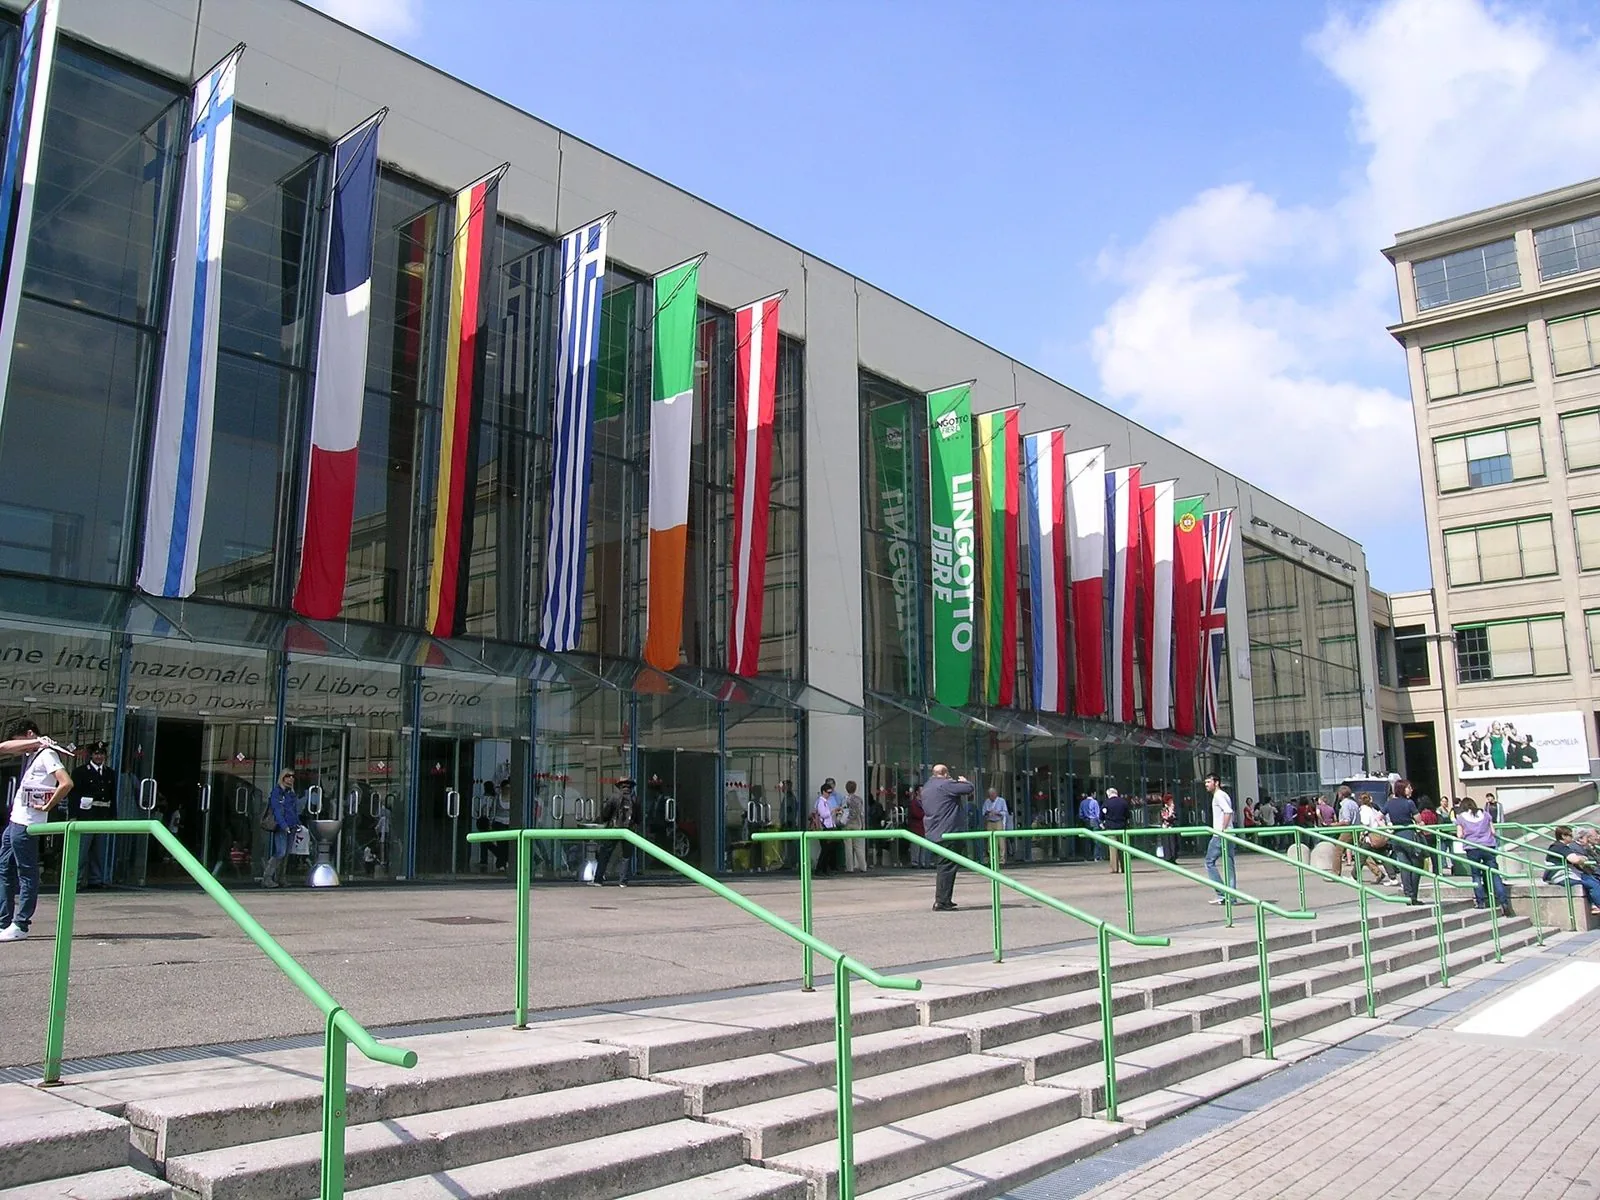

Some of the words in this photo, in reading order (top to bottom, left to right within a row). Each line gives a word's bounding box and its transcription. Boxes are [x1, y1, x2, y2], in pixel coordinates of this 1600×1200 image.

[932, 523, 953, 604] FIERE
[951, 472, 975, 653] LINGOTTO
[0, 646, 43, 664] ne
[55, 646, 260, 686] Intenazionale
[286, 673, 310, 690] el
[314, 675, 378, 697] Libro
